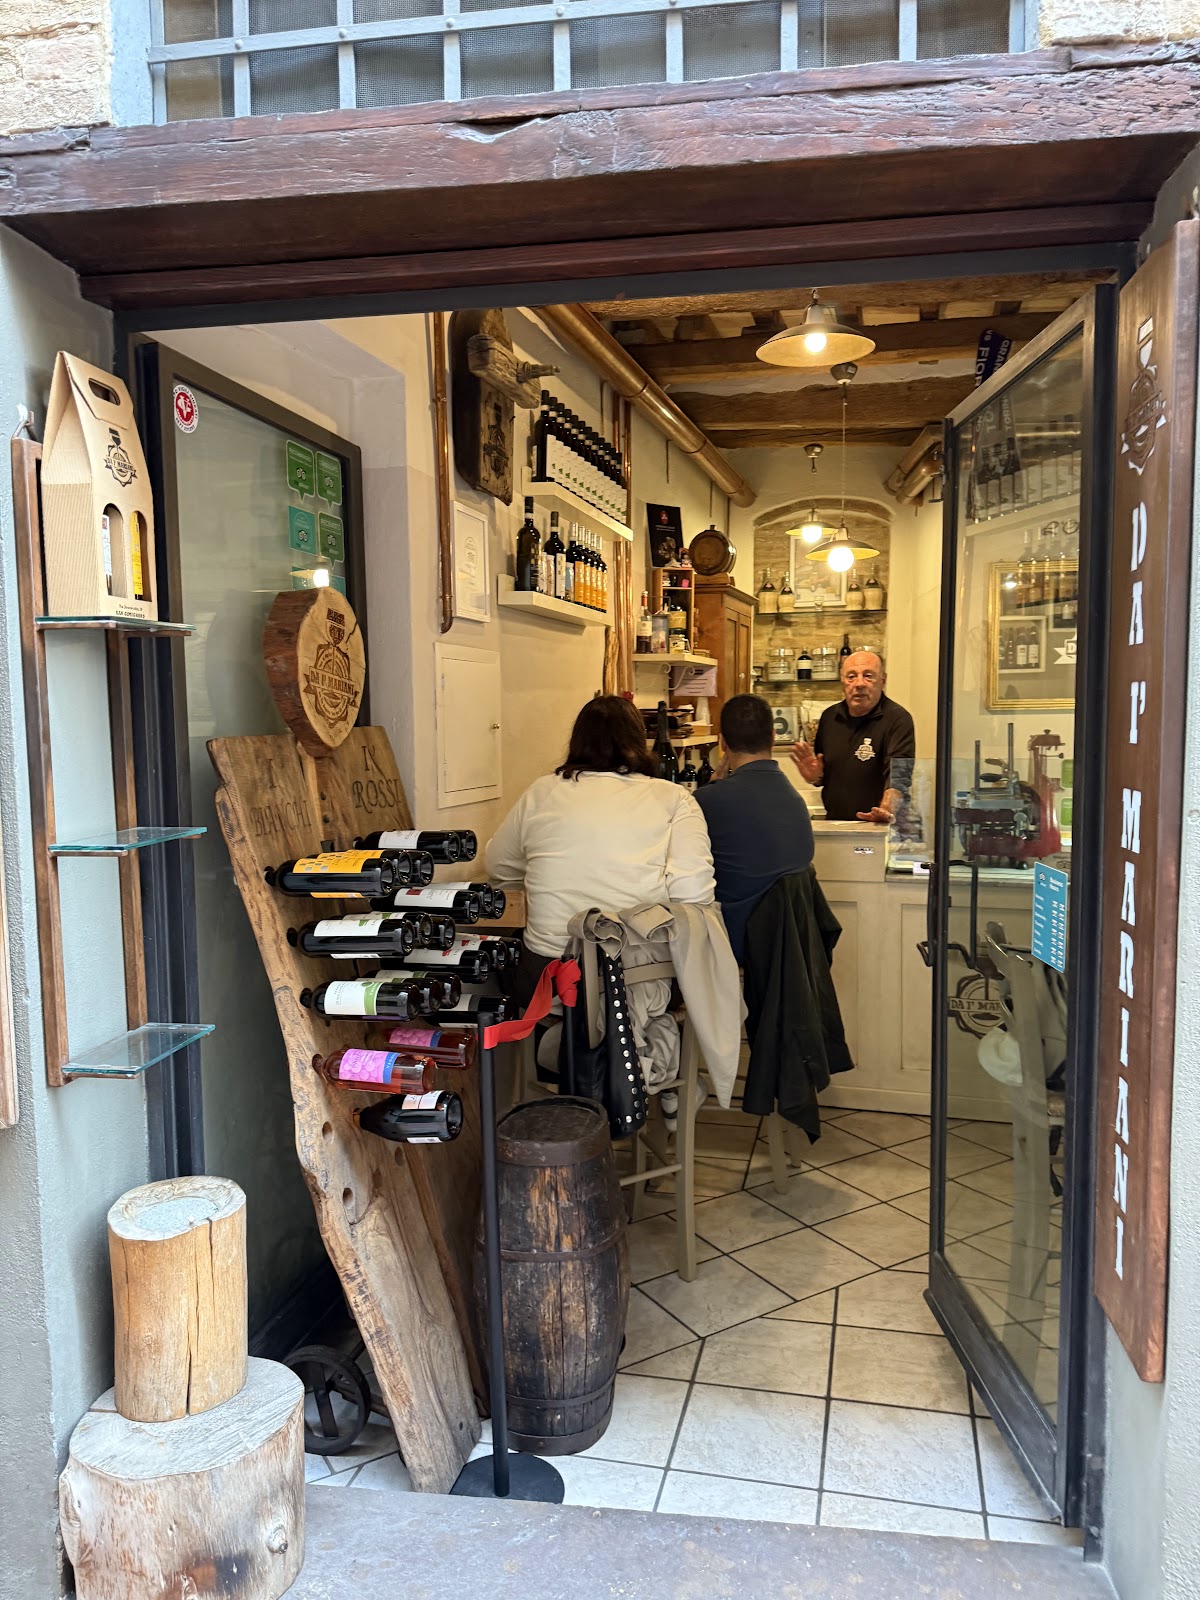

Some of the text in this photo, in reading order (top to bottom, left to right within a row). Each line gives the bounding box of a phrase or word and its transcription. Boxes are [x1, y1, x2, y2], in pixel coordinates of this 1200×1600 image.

[1002, 396, 1012, 431] TORIN
[311, 670, 320, 685] DA
[328, 676, 355, 695] MARIANI
[351, 777, 400, 814] ROSSI
[249, 800, 313, 837] BIANCHI
[1113, 788, 1143, 1281] MARIANI
